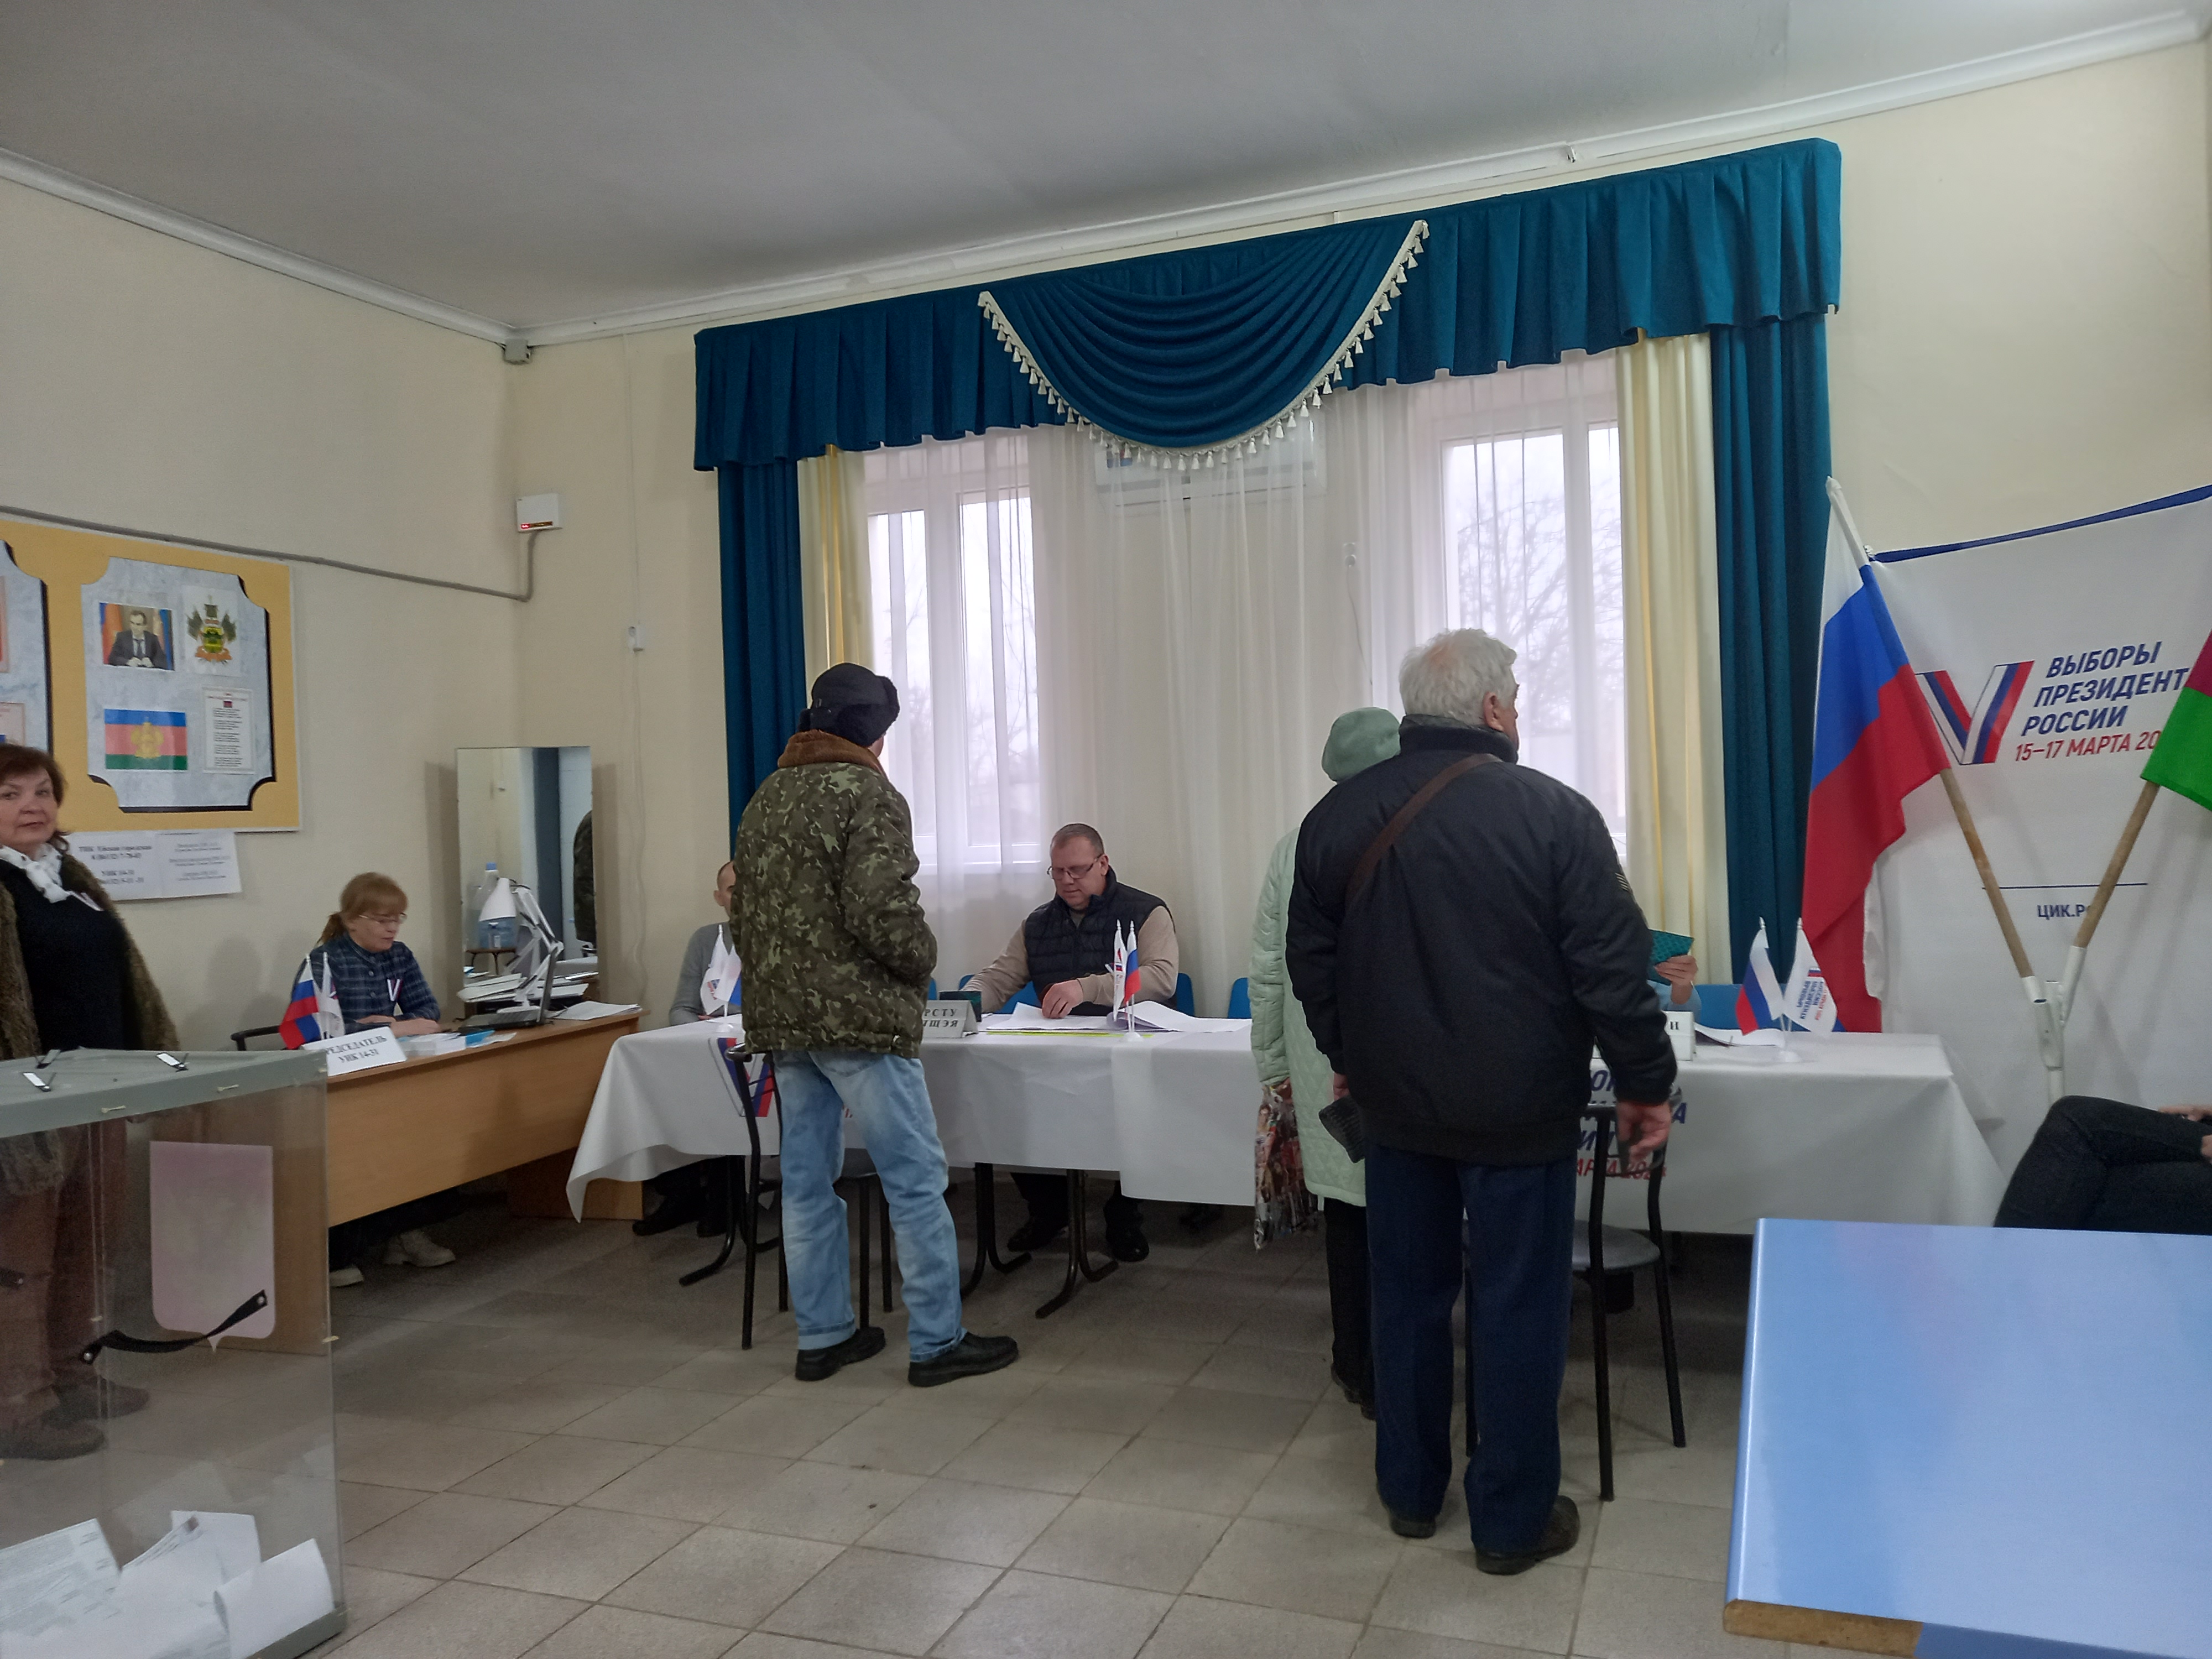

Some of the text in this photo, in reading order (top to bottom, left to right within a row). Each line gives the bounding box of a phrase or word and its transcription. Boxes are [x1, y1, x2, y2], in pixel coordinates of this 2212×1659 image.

[2046, 641, 2162, 679] ВЫБОРЫ
[2033, 667, 2190, 708] ПРЕЗИДЕНТ
[2021, 705, 2128, 737] РОССИИ
[2065, 733, 2132, 757] МАРТА
[2135, 730, 2162, 751] 20
[2037, 904, 2091, 921] ЦИК.Р
[326, 1035, 388, 1055] РЕДСЕДАТЕЛЬ
